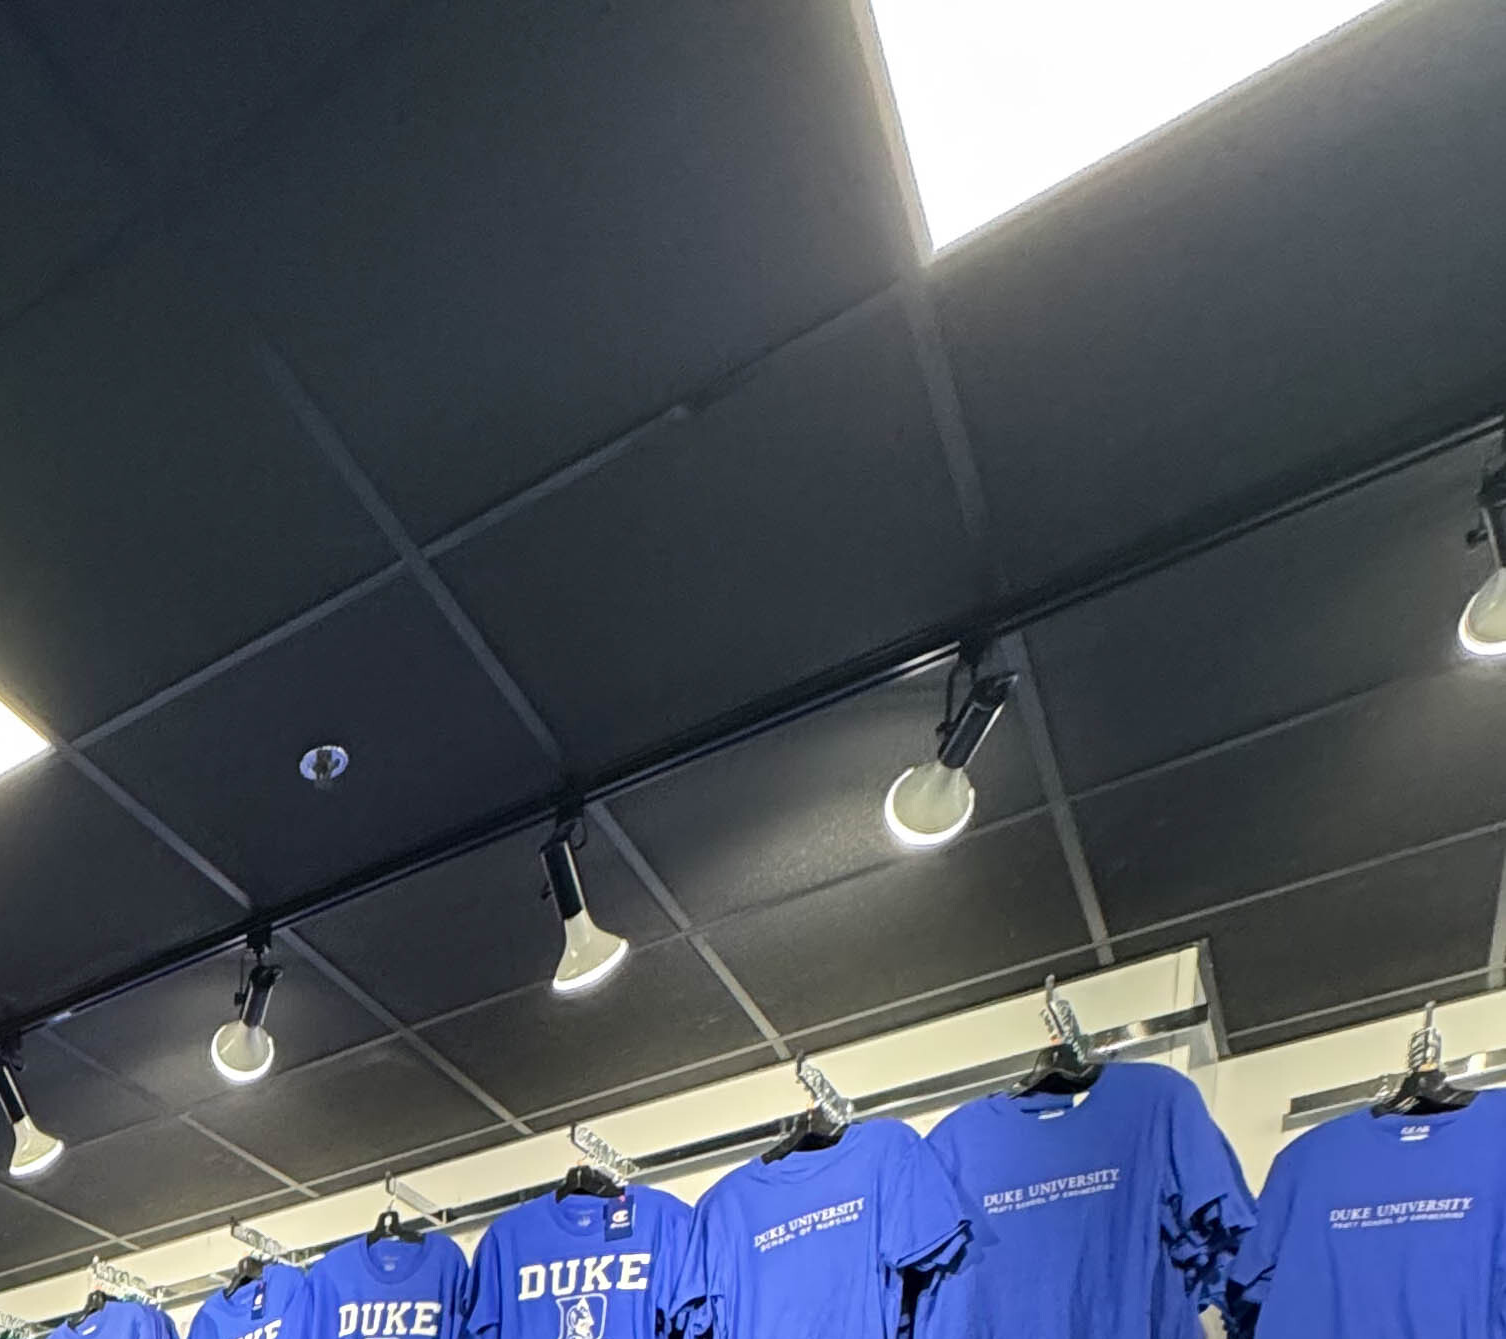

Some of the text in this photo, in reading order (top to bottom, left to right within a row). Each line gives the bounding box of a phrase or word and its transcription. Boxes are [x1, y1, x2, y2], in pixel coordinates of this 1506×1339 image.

[983, 1168, 1120, 1207] DUKE UNIVERSITY
[754, 1197, 865, 1248] DUKE UNIVERSITY
[1329, 1197, 1474, 1222] DUKE UNIVERSITY
[518, 1254, 651, 1301] DUKE
[338, 1302, 442, 1338] DUKE
